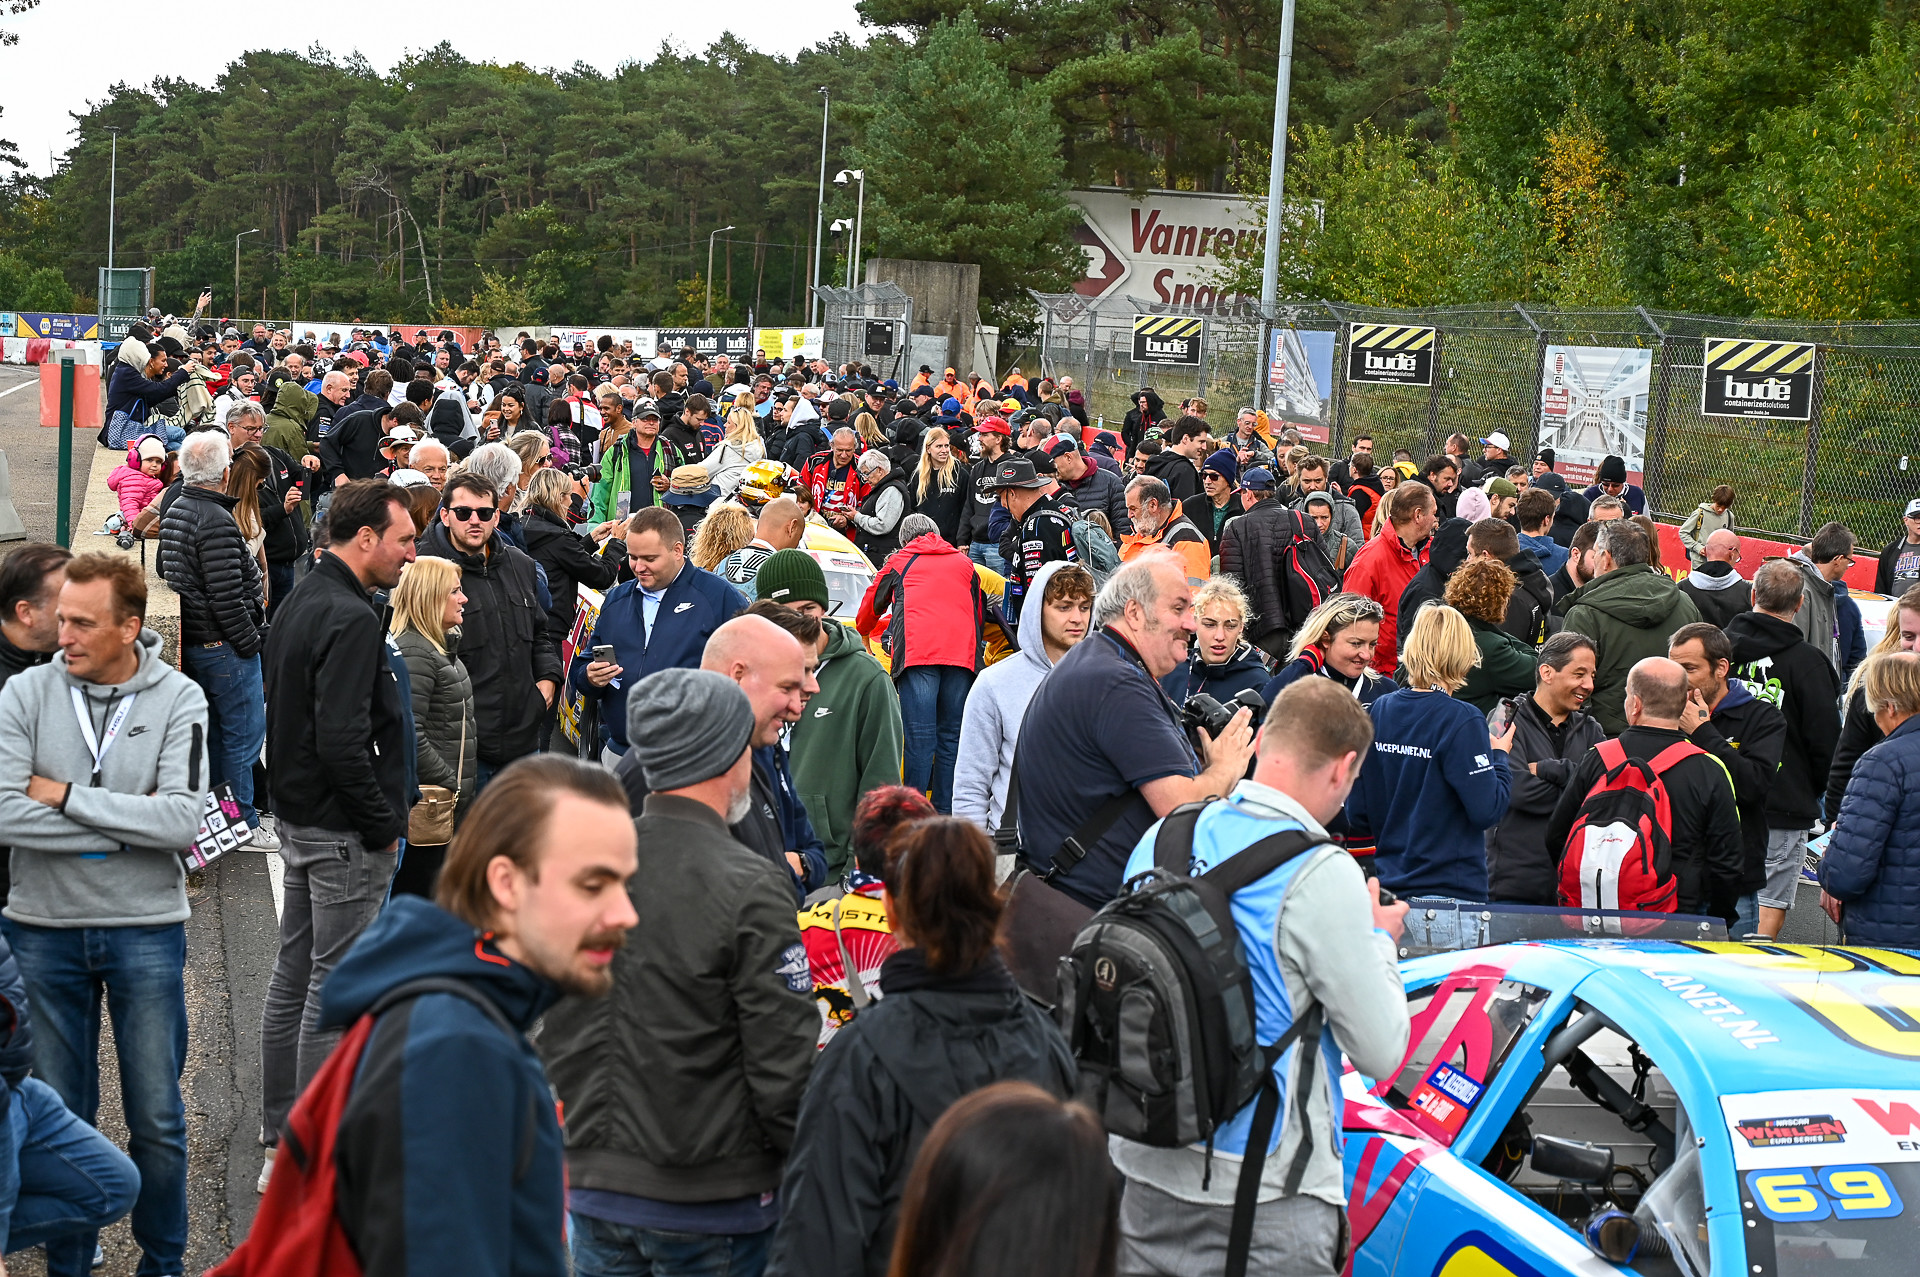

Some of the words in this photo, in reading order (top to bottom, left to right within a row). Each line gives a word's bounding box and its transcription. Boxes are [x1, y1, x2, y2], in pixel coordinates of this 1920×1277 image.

[1131, 208, 1262, 258] Vanreu
[1736, 1119, 1847, 1140] WHELEN
[1776, 1118, 1810, 1127] NASCAR
[1769, 1137, 1793, 1145] EURO
[1794, 1135, 1824, 1144] SERIES
[1745, 1163, 1904, 1223] 69
